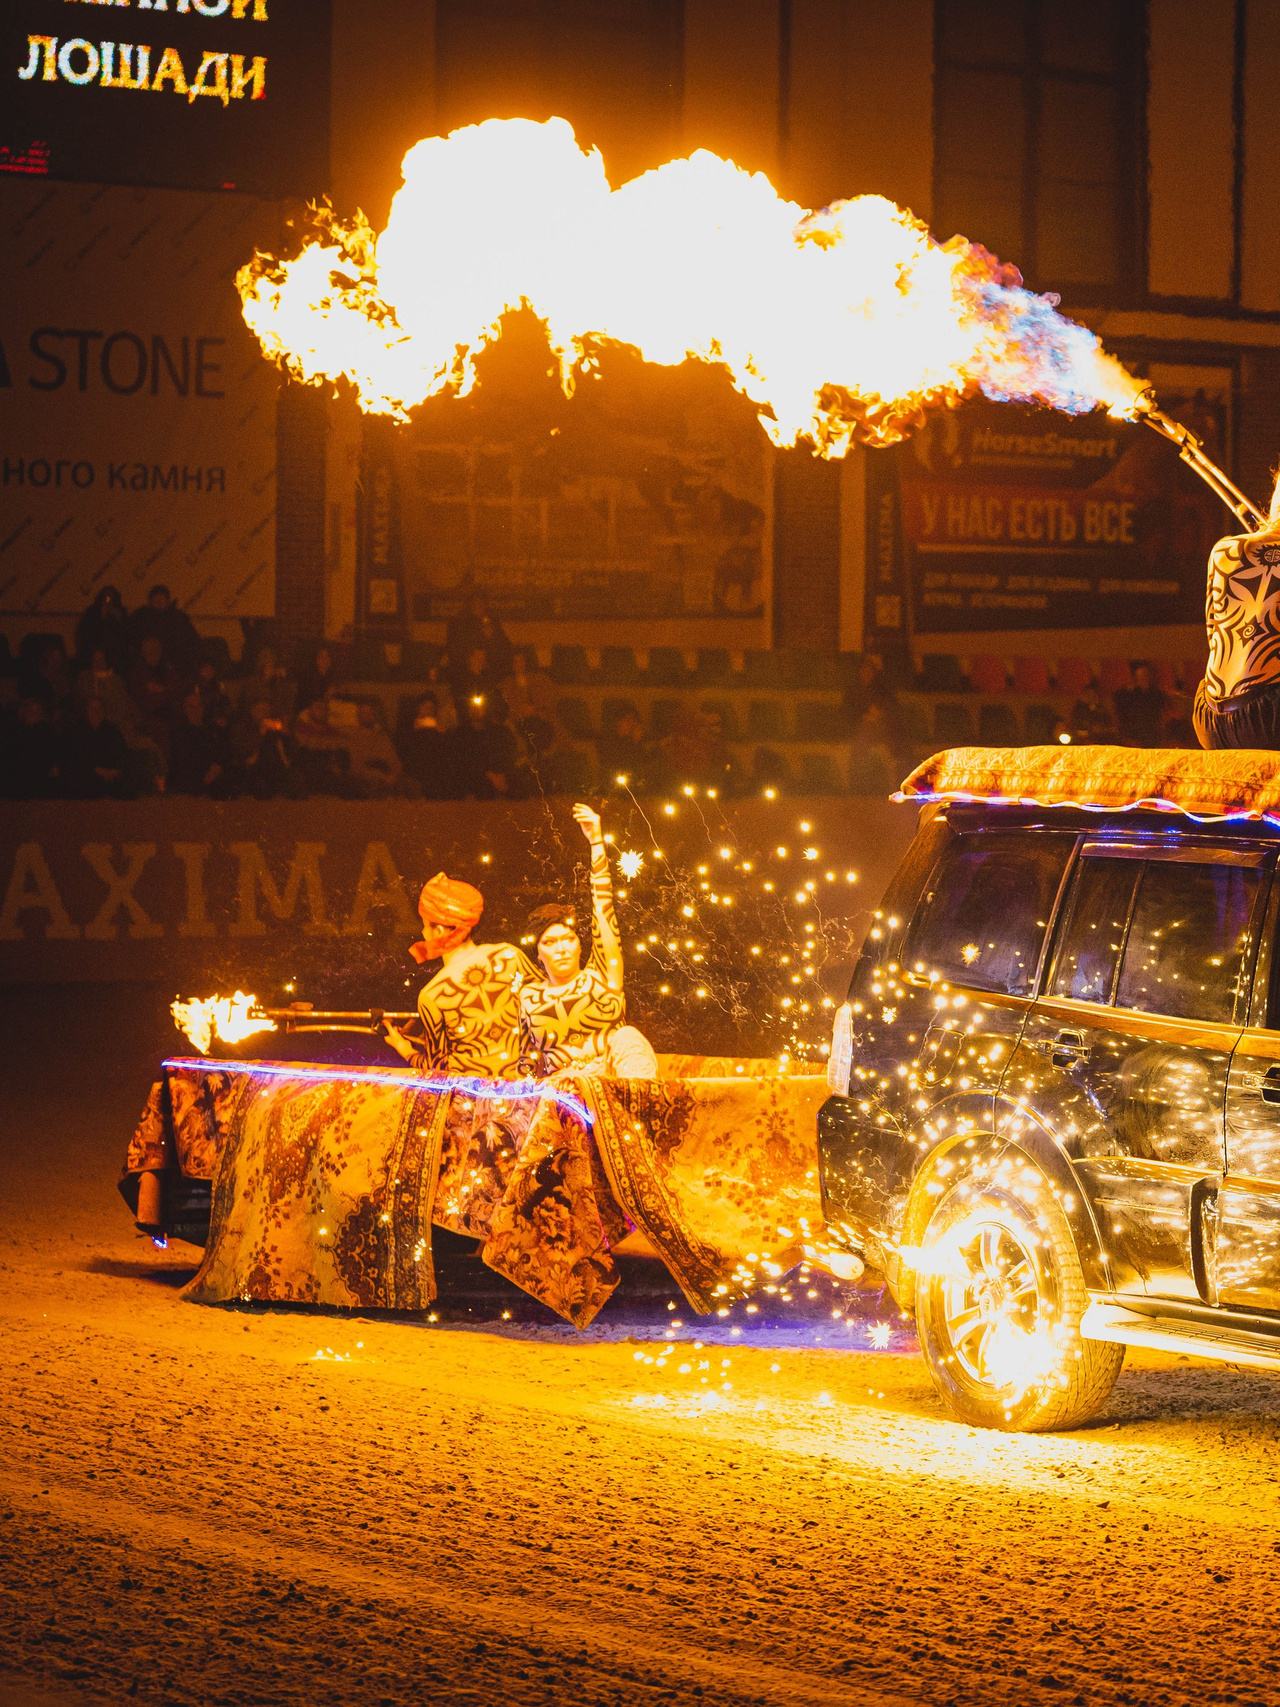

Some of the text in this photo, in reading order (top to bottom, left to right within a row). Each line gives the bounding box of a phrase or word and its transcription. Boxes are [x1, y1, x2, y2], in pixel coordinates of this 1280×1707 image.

[18, 34, 268, 108] ЛОШАДИ
[28, 326, 226, 398] STONE
[971, 427, 1118, 459] HorseSmart
[2, 457, 226, 493] ного камня
[920, 493, 1135, 544] У НАС ЕСТЬ ВСЕ
[0, 840, 422, 940] AXIMA
